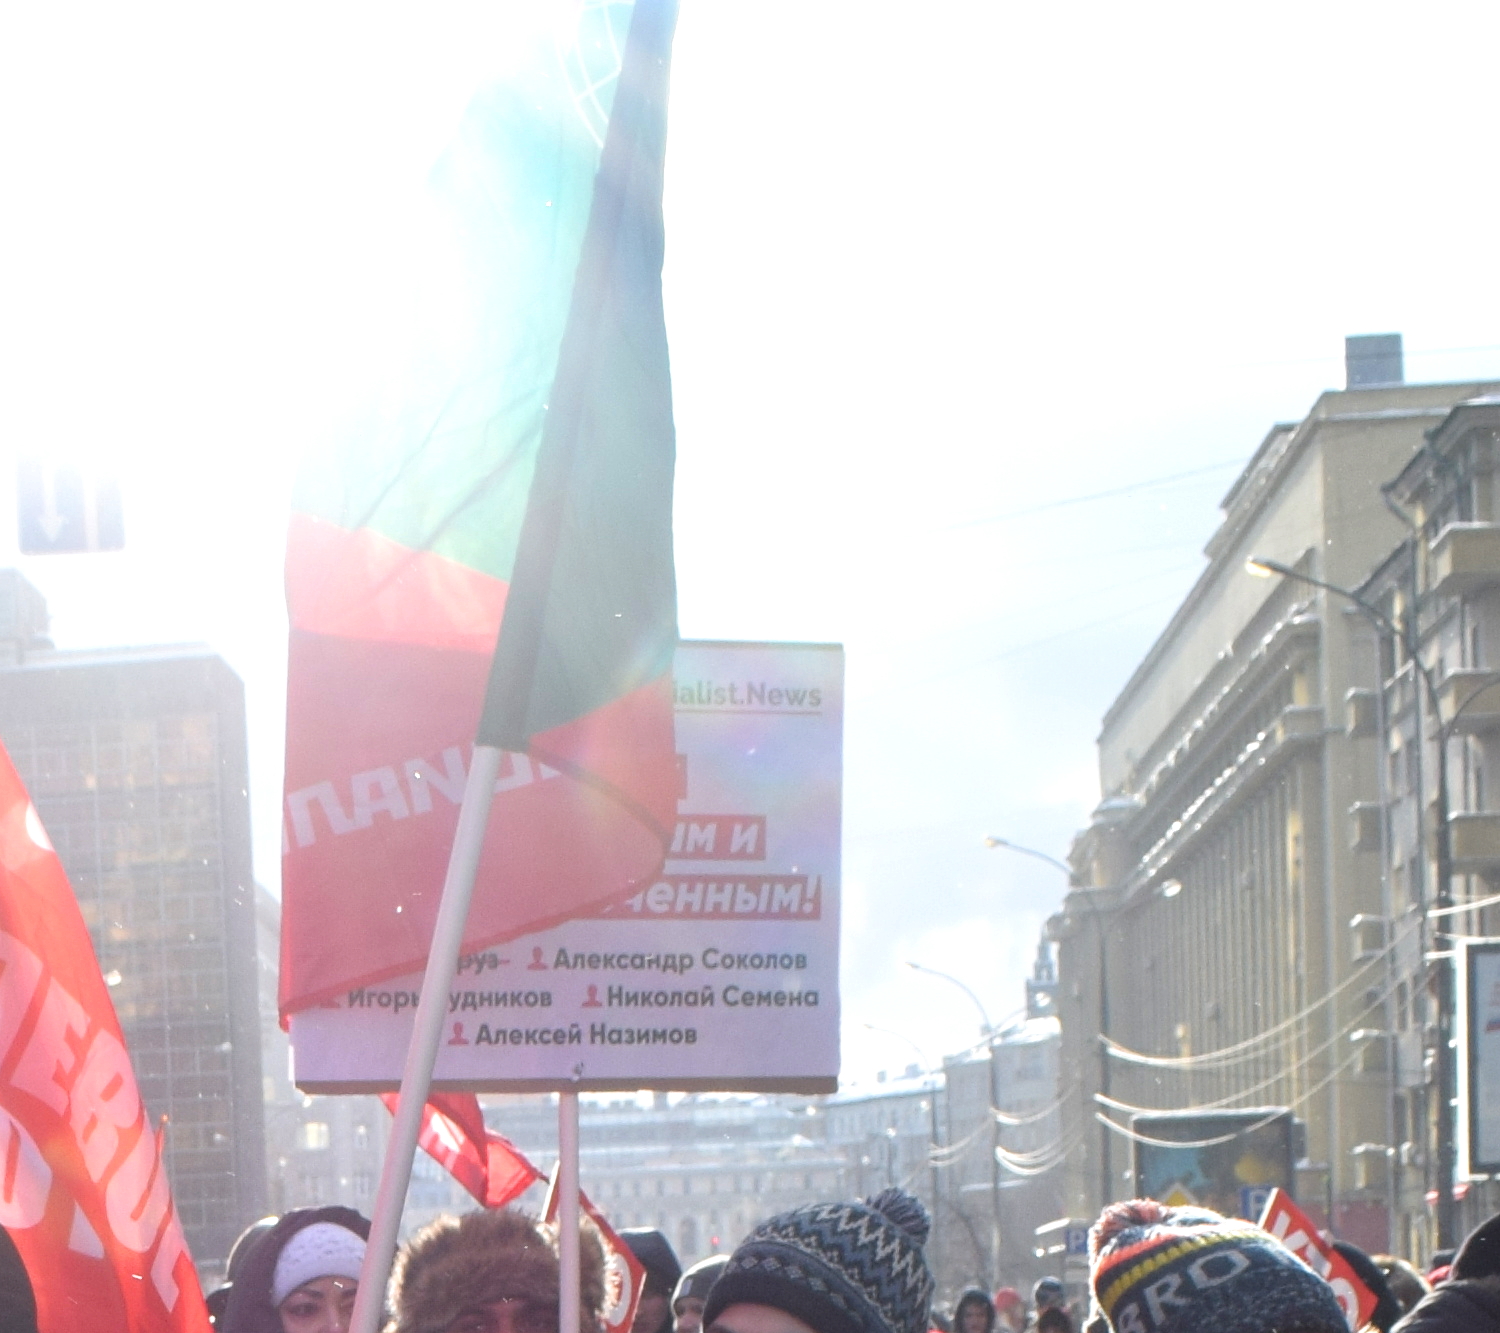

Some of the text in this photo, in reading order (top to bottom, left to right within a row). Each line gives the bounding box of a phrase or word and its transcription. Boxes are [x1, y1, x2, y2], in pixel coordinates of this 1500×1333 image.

[730, 826, 759, 853] и
[553, 948, 807, 975] Александр Соколов
[449, 988, 553, 1012] удников
[607, 985, 820, 1009] Николай Семена
[475, 1022, 698, 1046] Алексей Назимов
